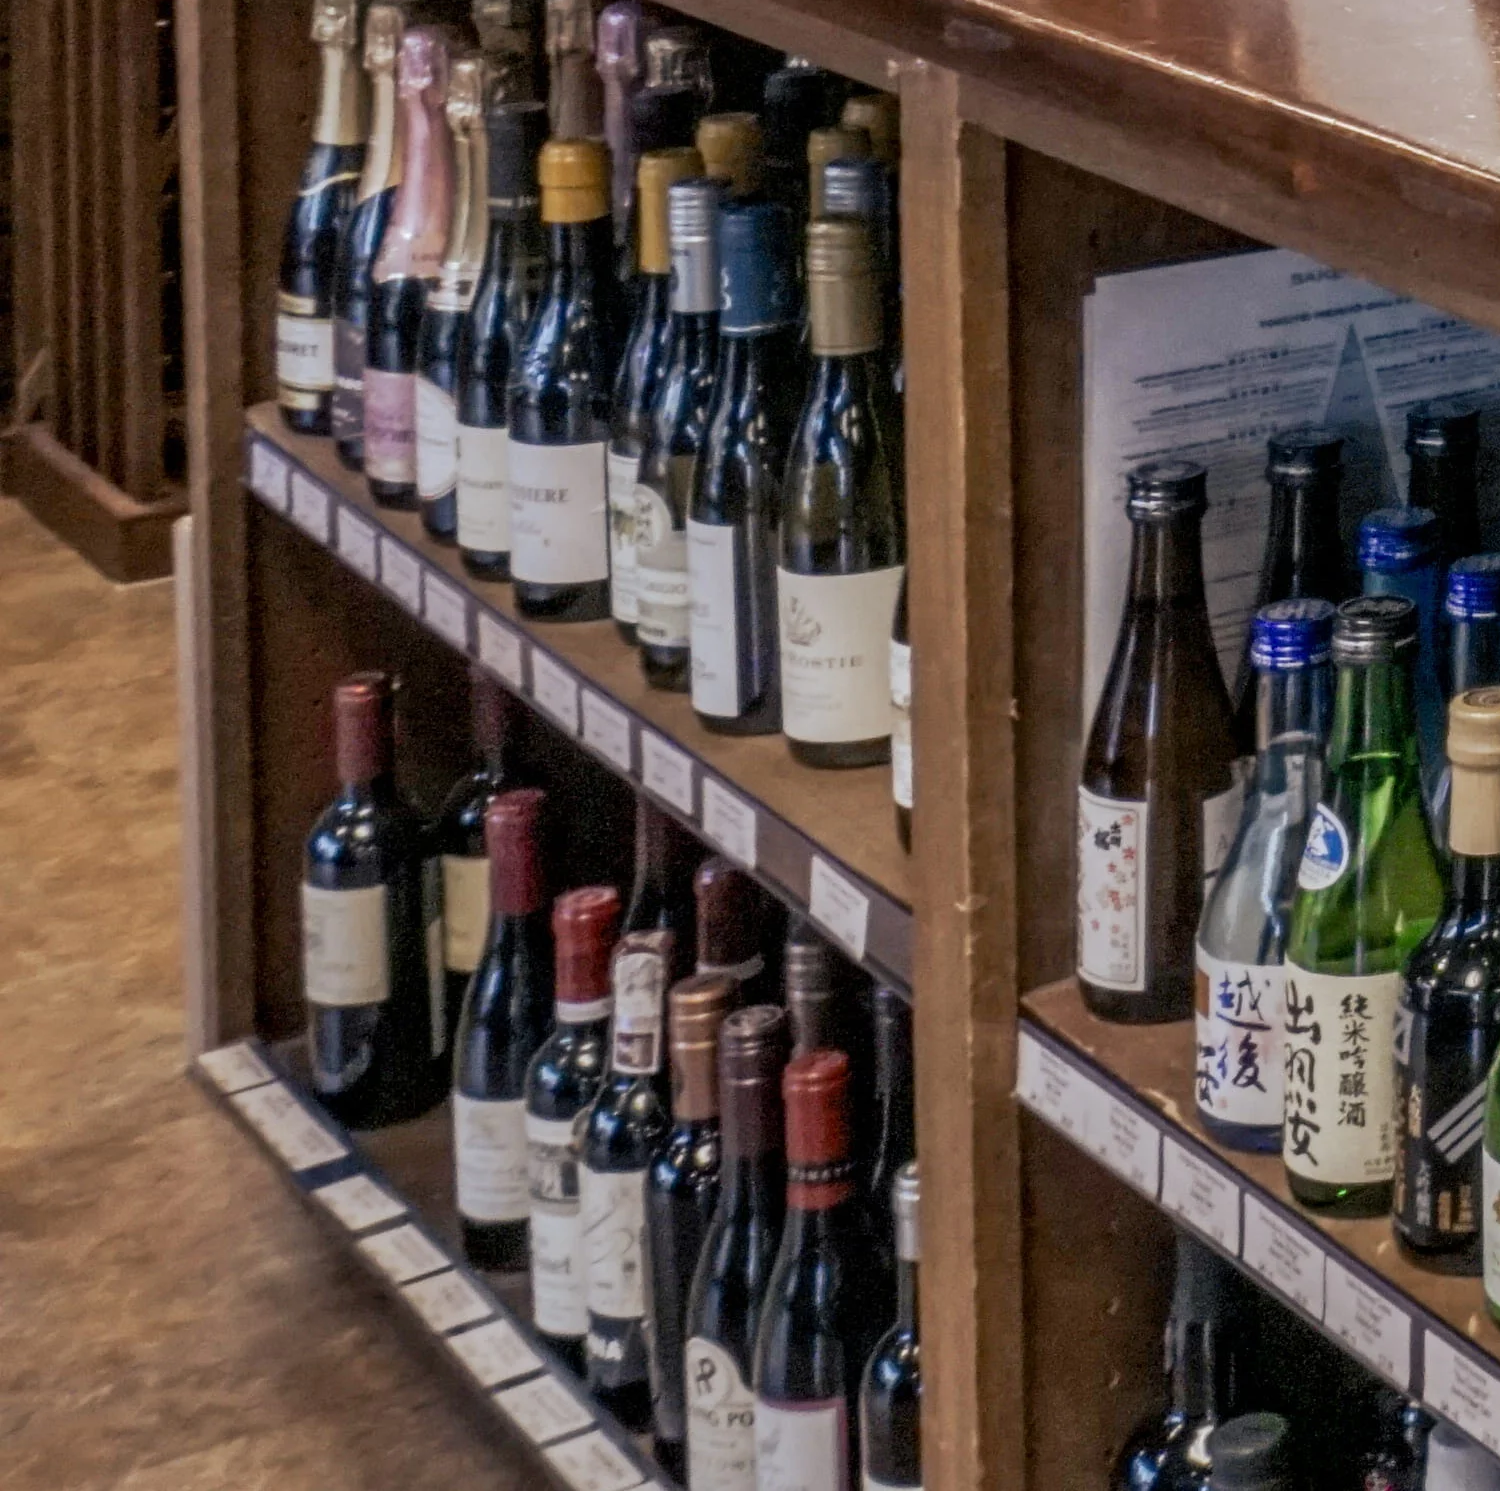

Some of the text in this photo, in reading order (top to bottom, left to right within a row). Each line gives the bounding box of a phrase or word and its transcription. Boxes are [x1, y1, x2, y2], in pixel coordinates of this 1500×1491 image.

[1337, 994, 1373, 1128] 純米吟醸酒
